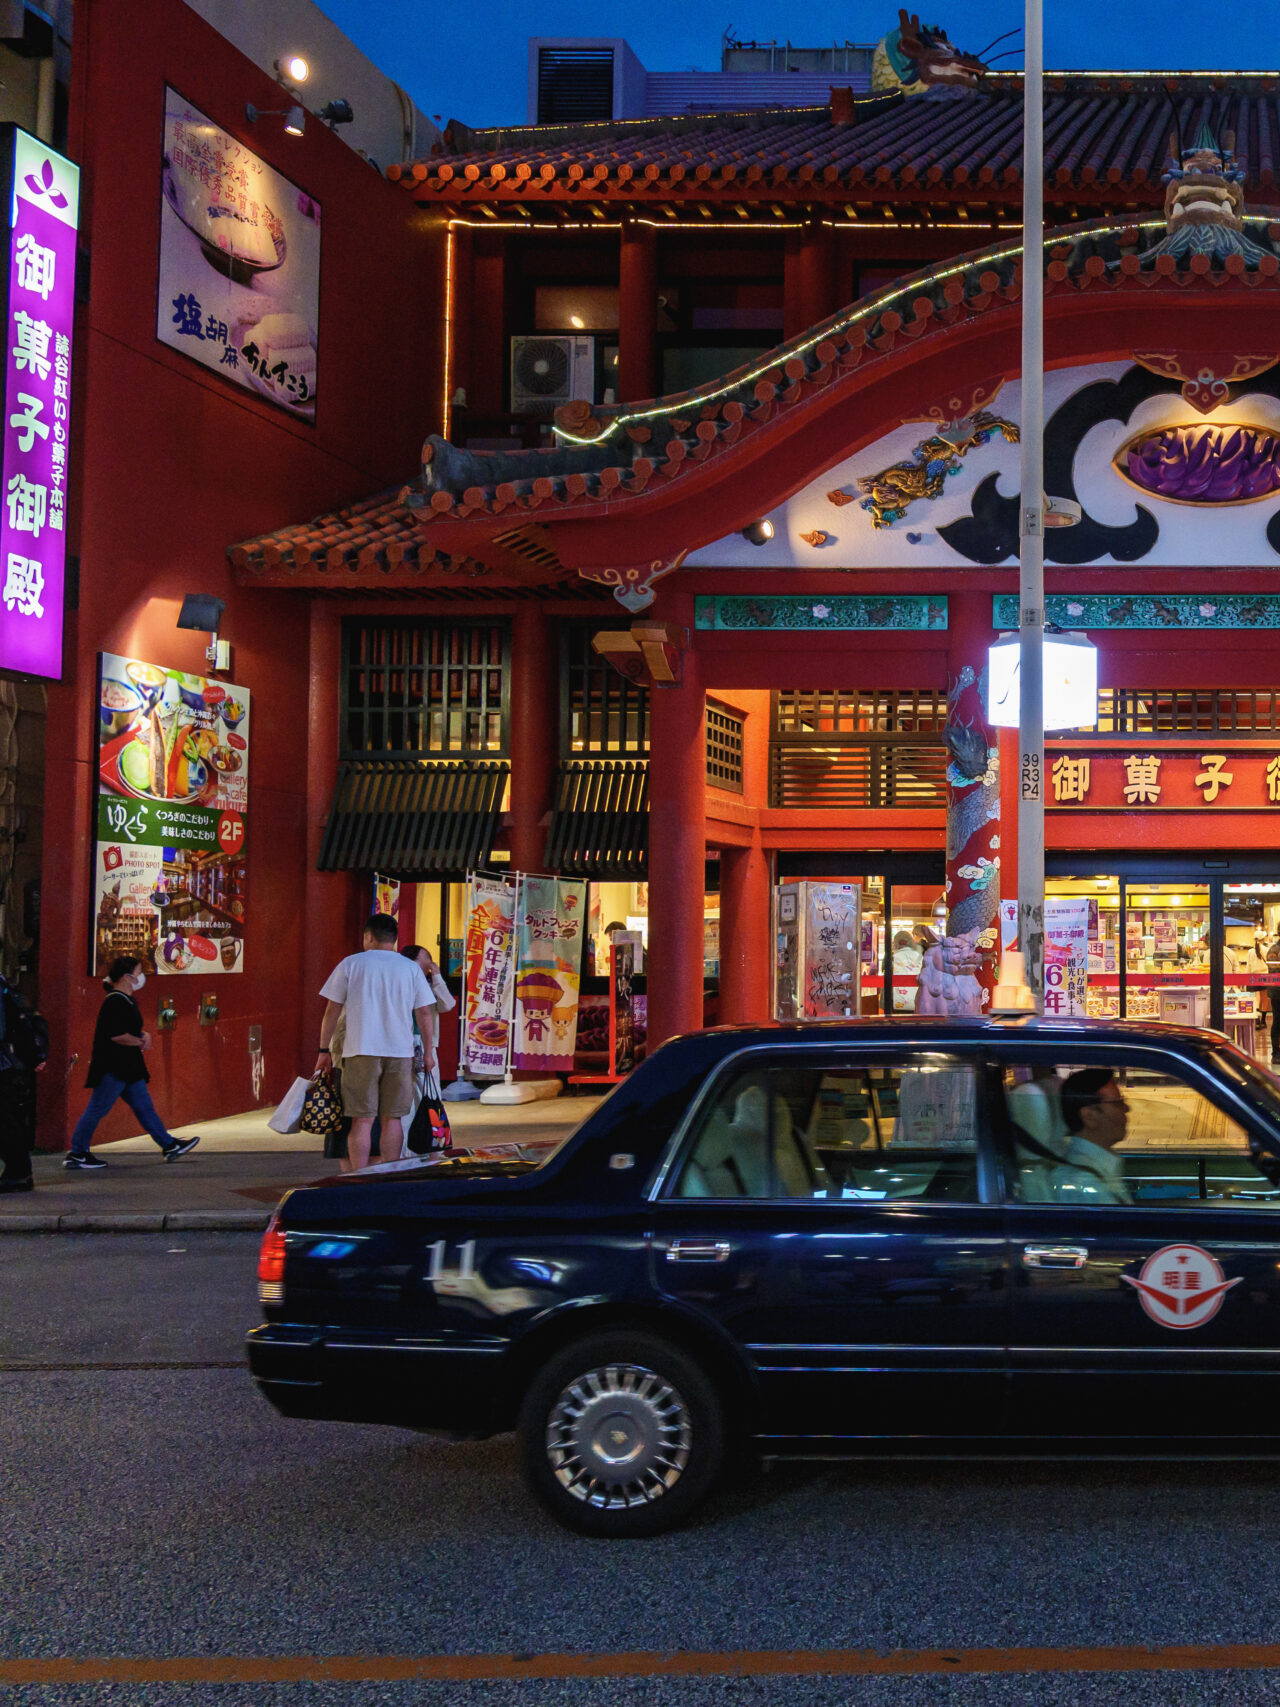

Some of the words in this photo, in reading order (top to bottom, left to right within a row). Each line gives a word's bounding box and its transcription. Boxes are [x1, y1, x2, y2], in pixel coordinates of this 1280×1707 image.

[3, 233, 57, 619] 御菓子御殿
[1022, 753, 1039, 768] 39
[1021, 768, 1040, 782] R3
[1021, 783, 1040, 797] P4
[160, 825, 216, 841] 美味しさのこだわり
[221, 820, 243, 841] 2F
[1162, 1270, 1202, 1290] 明星
